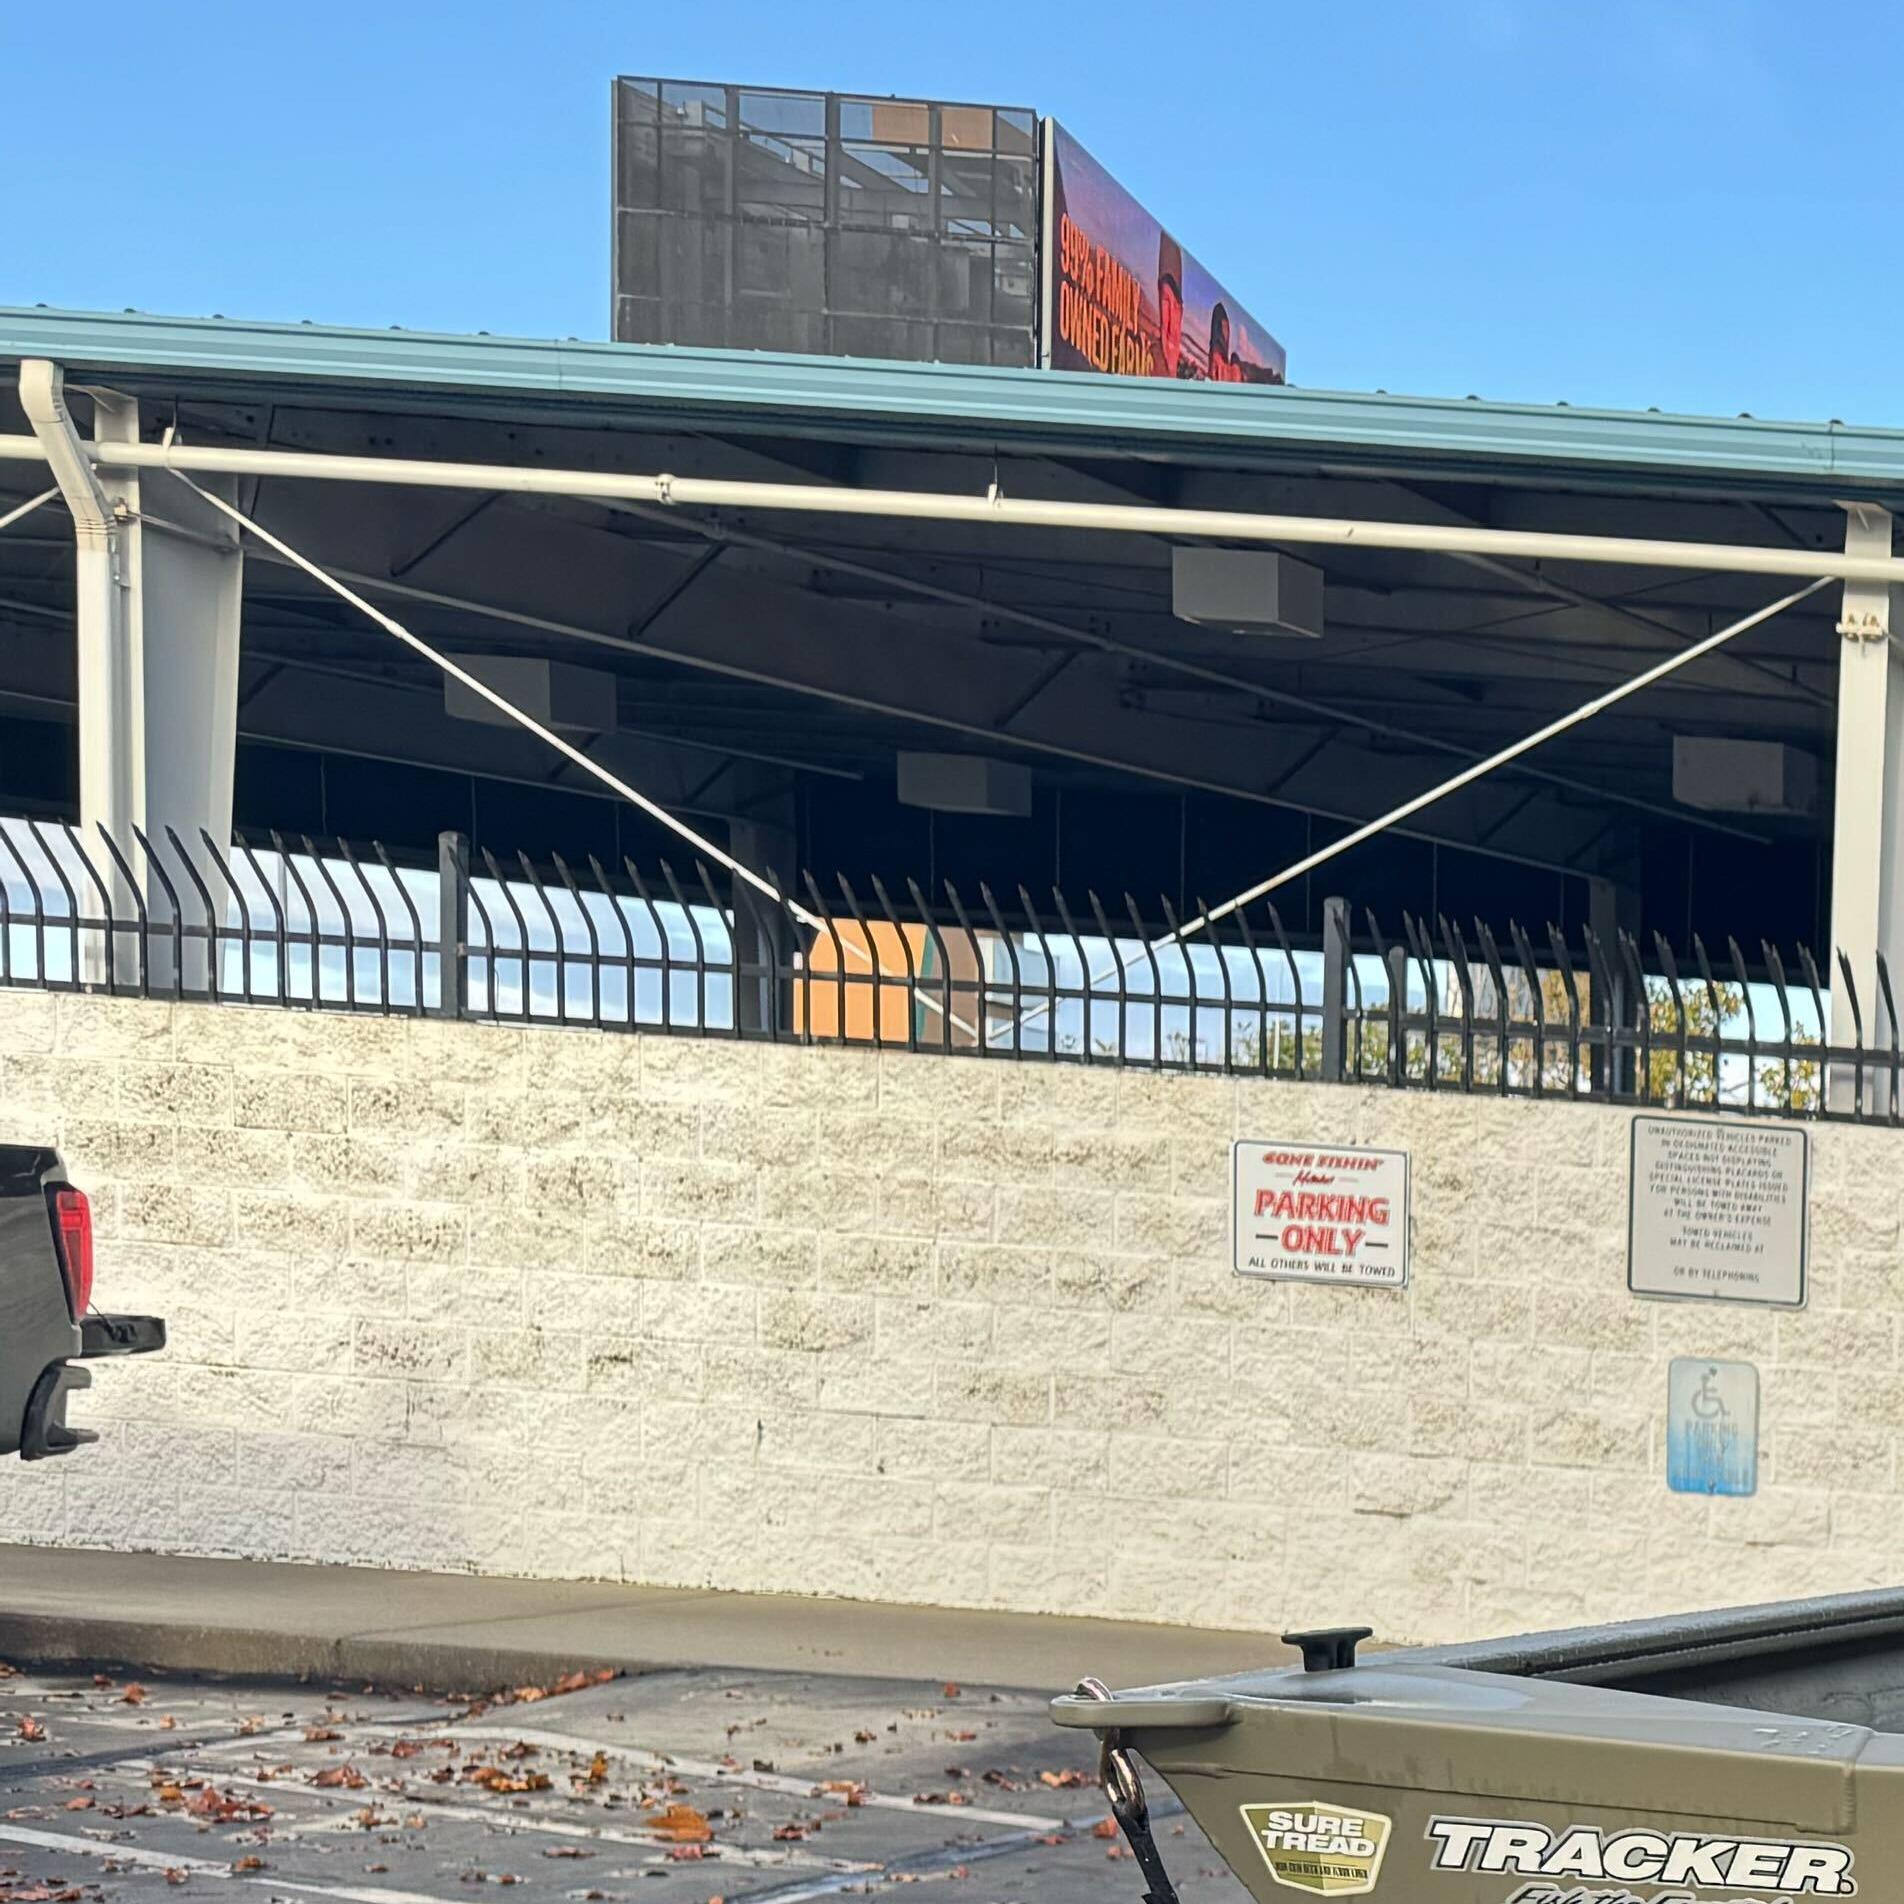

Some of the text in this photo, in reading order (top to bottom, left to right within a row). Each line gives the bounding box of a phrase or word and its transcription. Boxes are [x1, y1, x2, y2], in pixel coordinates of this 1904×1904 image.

[1061, 213, 1141, 334] 99% FAMILY
[1060, 281, 1110, 373] OWNED
[1262, 1151, 1314, 1167] GONE
[1254, 1188, 1391, 1226] PARKING
[1281, 1224, 1366, 1258] ONLY
[1248, 1256, 1395, 1278] ALL OTHERS WILL BE TOWED
[1267, 1810, 1364, 1837] SURE
[1261, 1829, 1376, 1857] TREAD
